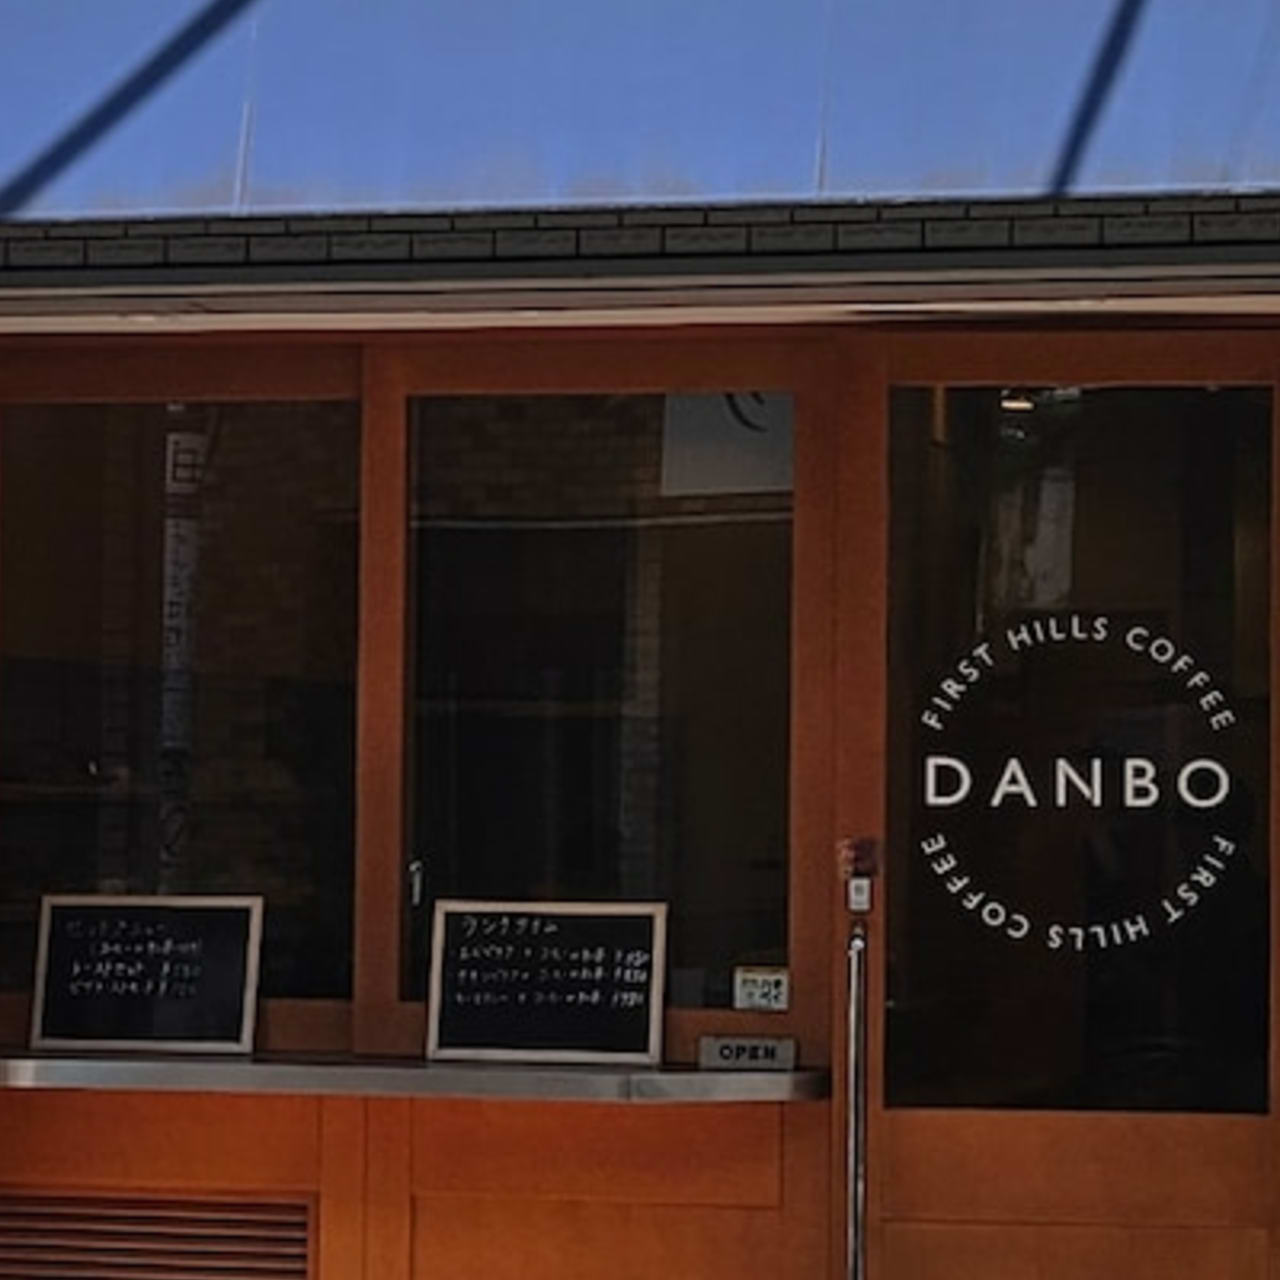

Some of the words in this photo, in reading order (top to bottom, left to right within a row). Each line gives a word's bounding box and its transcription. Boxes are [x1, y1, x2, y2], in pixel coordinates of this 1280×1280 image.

[921, 642, 997, 732] FIRST
[1005, 614, 1110, 651] HILLS
[1124, 626, 1237, 731] COFFEE
[925, 755, 1231, 809] DANBO
[920, 833, 1031, 939] COFFEE
[1160, 834, 1236, 924] FIRST
[1046, 914, 1150, 952] HILLS
[719, 1044, 777, 1061] OPEN
